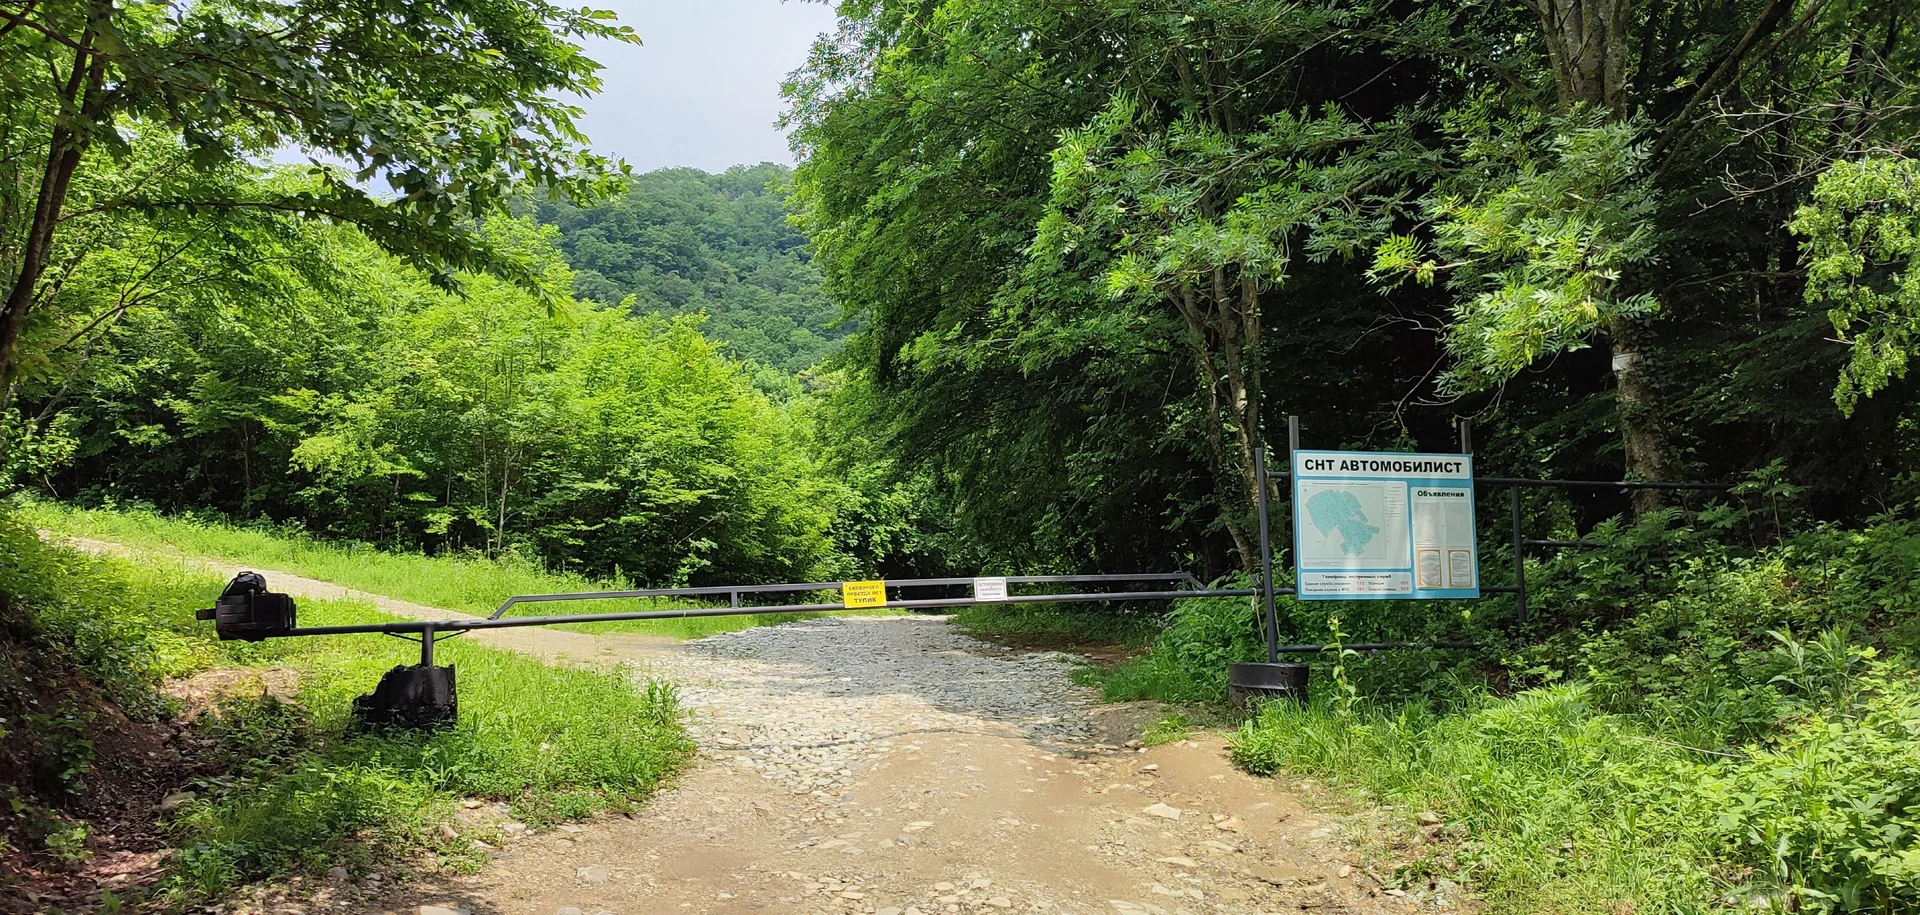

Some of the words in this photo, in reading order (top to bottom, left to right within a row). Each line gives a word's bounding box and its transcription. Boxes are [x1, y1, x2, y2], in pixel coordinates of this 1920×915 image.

[1305, 459, 1335, 471] СНТ
[1340, 460, 1462, 473] АВТОМОБИЛИСТ
[1417, 490, 1465, 498] Объявления
